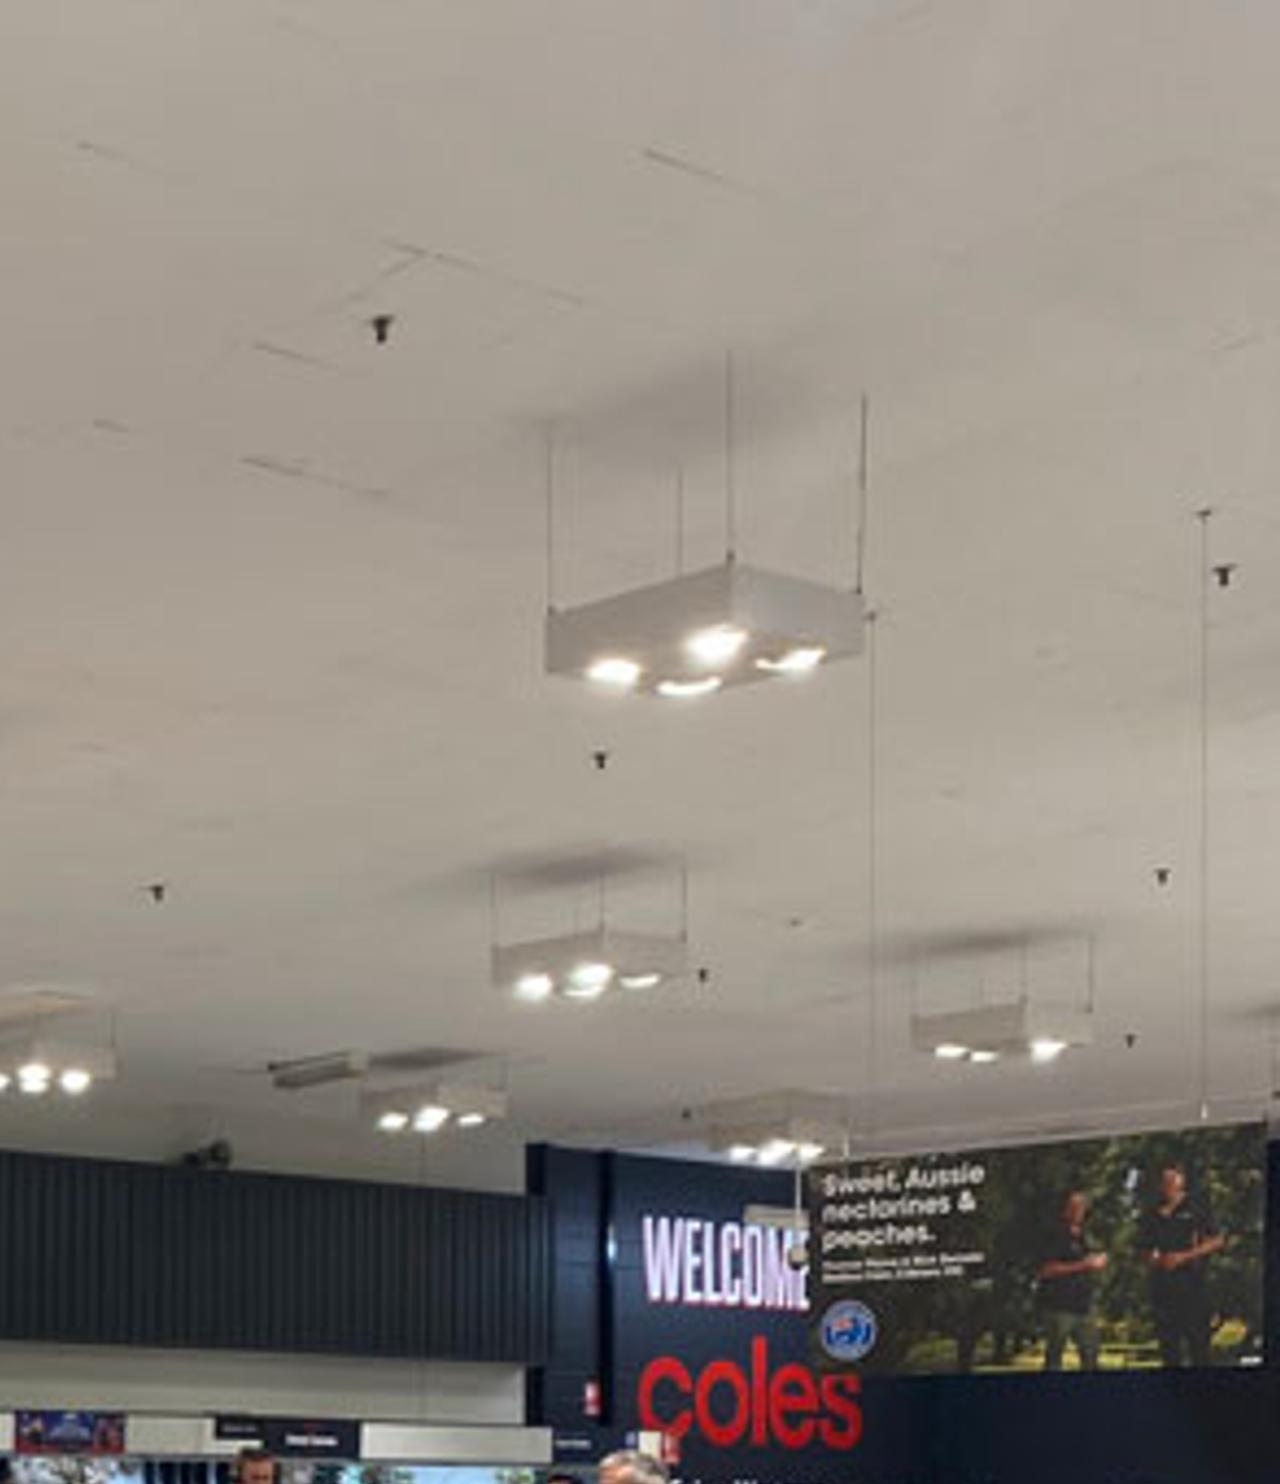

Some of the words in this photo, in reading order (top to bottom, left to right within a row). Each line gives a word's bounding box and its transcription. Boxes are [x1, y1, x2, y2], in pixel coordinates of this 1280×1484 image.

[904, 1161, 986, 1189] Aussie
[822, 1195, 953, 1223] nectarines
[956, 1189, 978, 1213] &
[637, 1334, 862, 1450] coles
